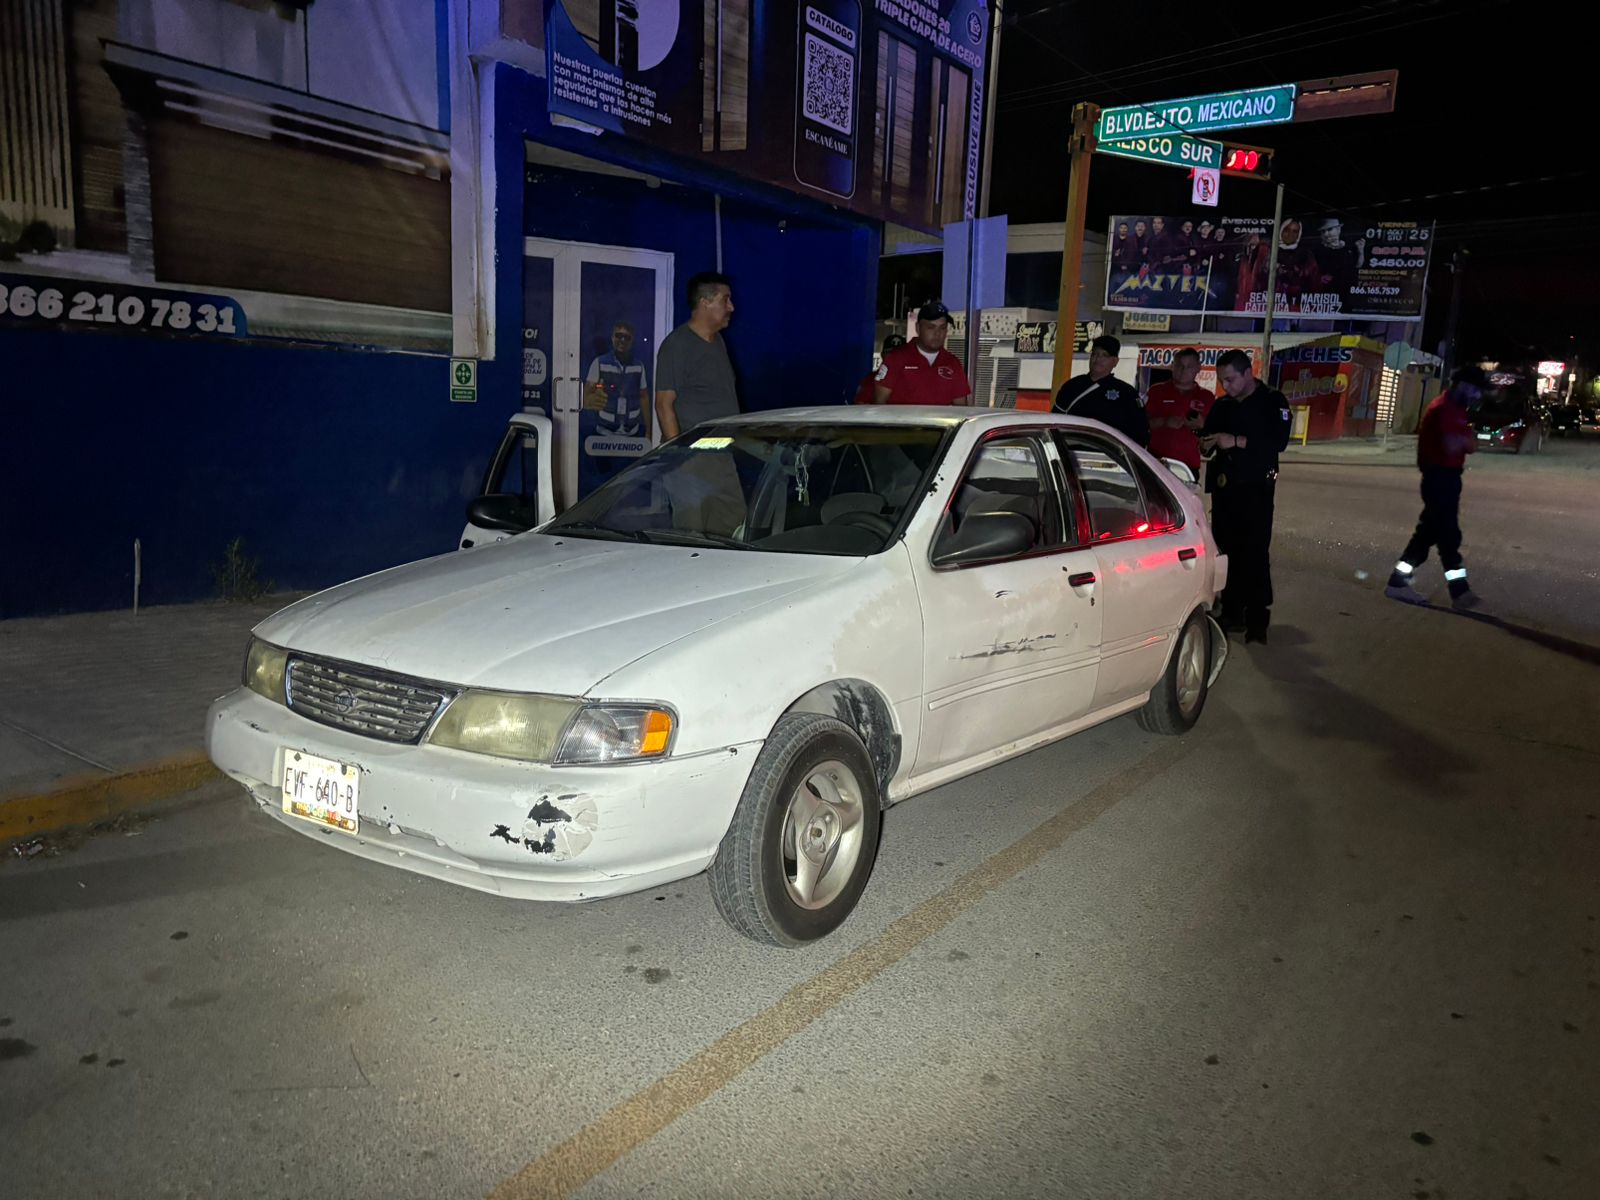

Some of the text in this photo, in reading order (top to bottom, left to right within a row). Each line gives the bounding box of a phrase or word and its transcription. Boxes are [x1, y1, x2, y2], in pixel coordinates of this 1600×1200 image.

[808, 10, 854, 42] CATALOGO
[909, 17, 937, 44] CAPA
[937, 35, 950, 51] DE
[950, 42, 982, 68] ACERO
[554, 51, 657, 99] Nuestras puertas cuentan
[554, 64, 655, 108] con mecanismos de alta
[554, 75, 672, 125] seguridad que las hacen más
[554, 86, 651, 127] resistentes a intrusiones
[972, 81, 981, 123] LINE
[1197, 95, 1276, 123] MEXICANO
[1180, 141, 1213, 164] SUR
[1366, 228, 1382, 239] 01
[1409, 229, 1429, 240] 25
[1369, 258, 1425, 267] $450.00
[68, 291, 145, 325] 210
[150, 299, 192, 329] 78
[196, 303, 236, 334] 31
[1249, 290, 1287, 304] SEÑRA
[1300, 292, 1342, 304] MARISOL
[1139, 349, 1177, 365] TACOS
[592, 442, 643, 452] BIENVENIDO
